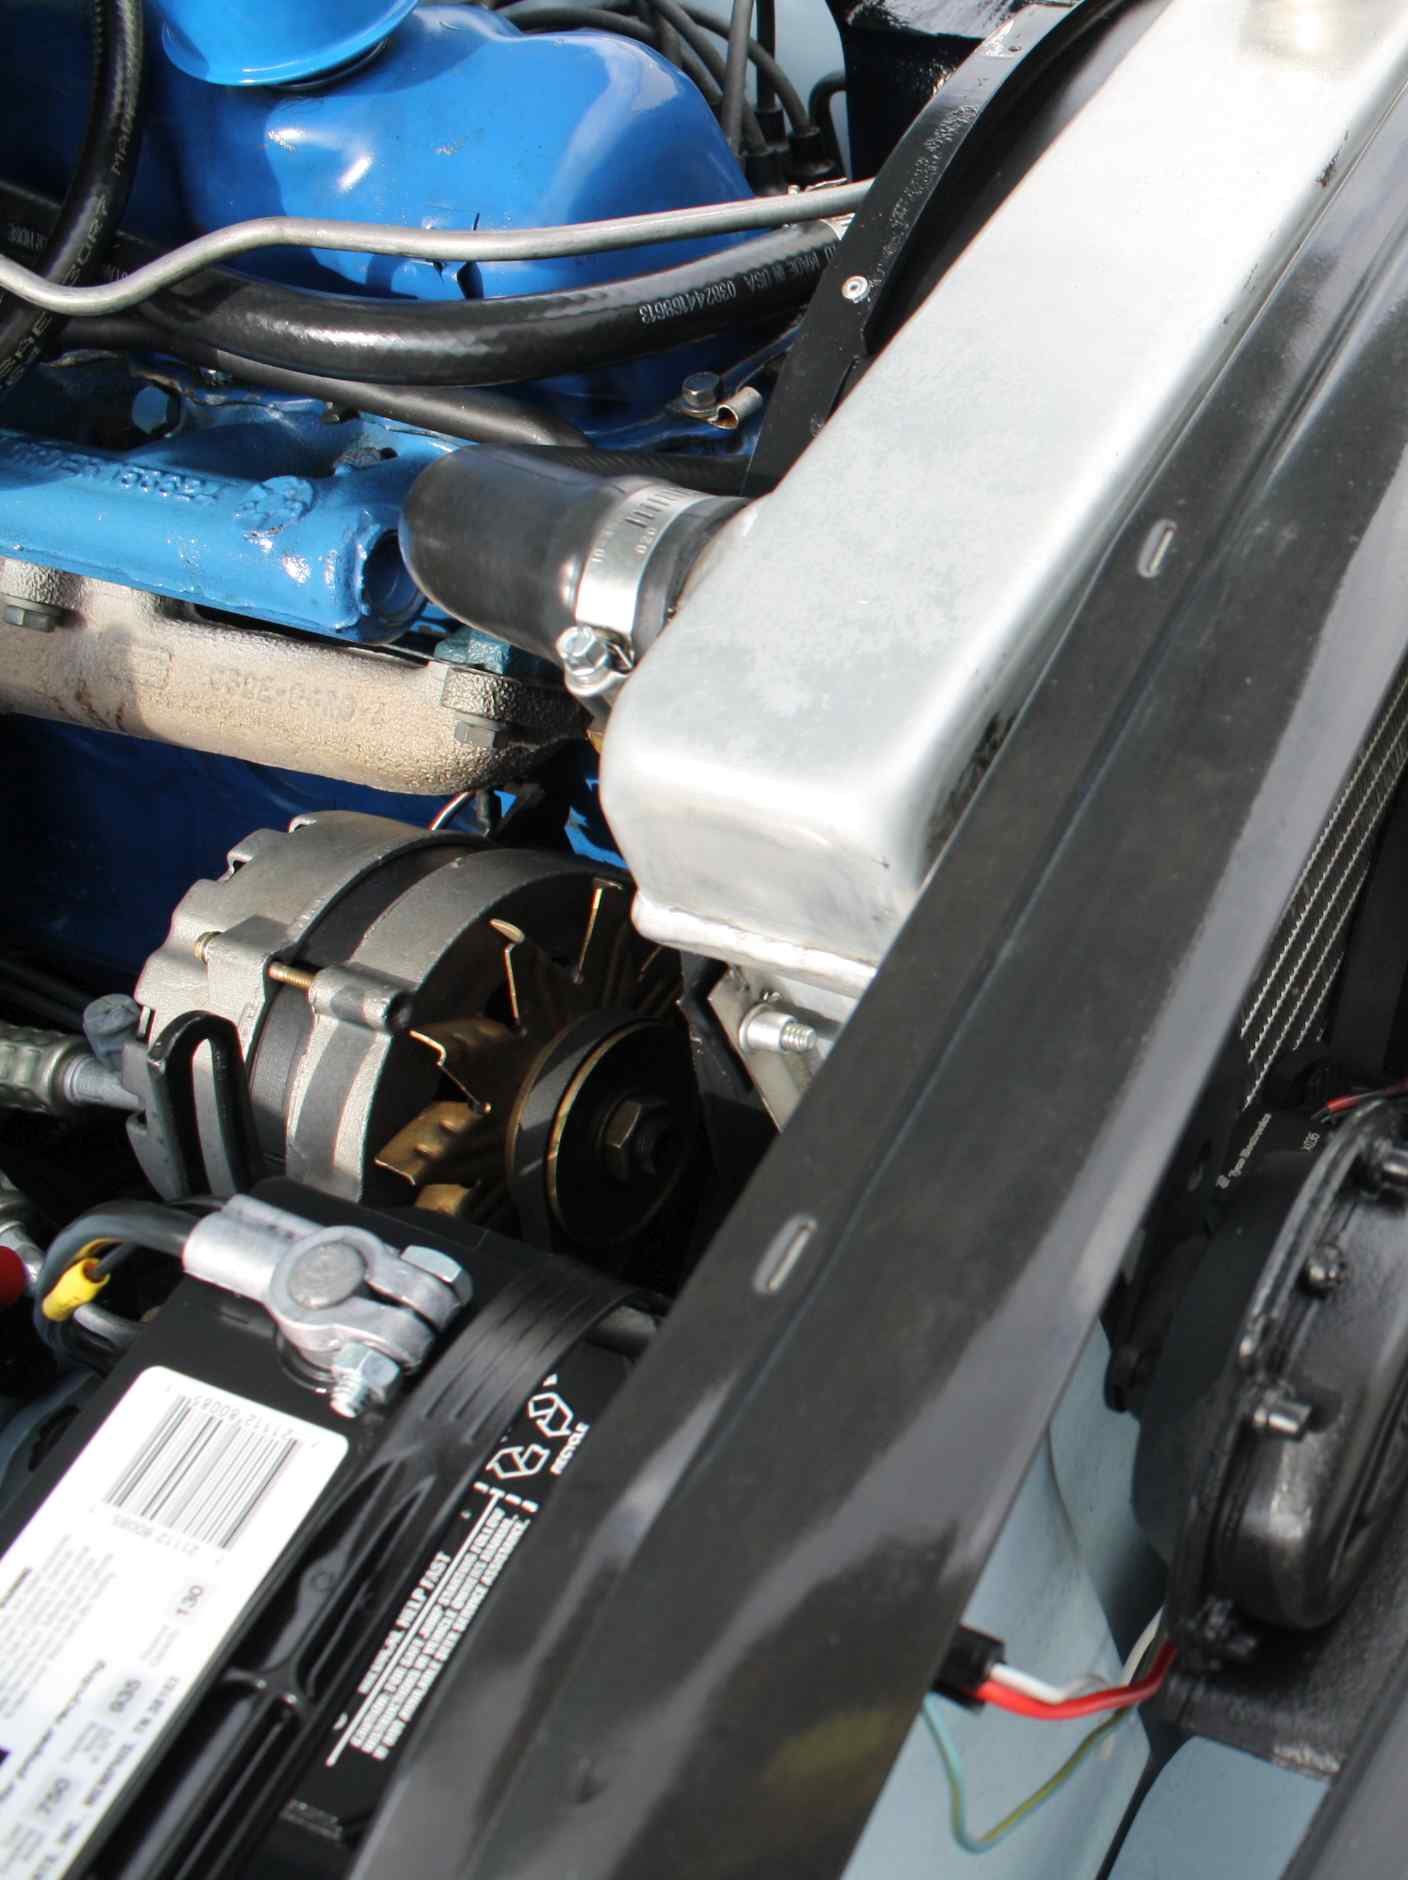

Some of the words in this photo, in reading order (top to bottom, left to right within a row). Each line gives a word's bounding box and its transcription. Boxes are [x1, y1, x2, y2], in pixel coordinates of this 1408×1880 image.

[743, 268, 770, 292] USA
[1240, 1114, 1271, 1158] Electronics
[550, 1422, 589, 1474] RECYCLE
[470, 1507, 505, 1556] FOLLOW
[177, 1585, 204, 1617] 130
[396, 1587, 427, 1629] HELP
[419, 1551, 451, 1590] FAST
[397, 1658, 443, 1722] AVAILABLE
[451, 1582, 488, 1633] SERVICE
[422, 1608, 459, 1656] VEHICLE
